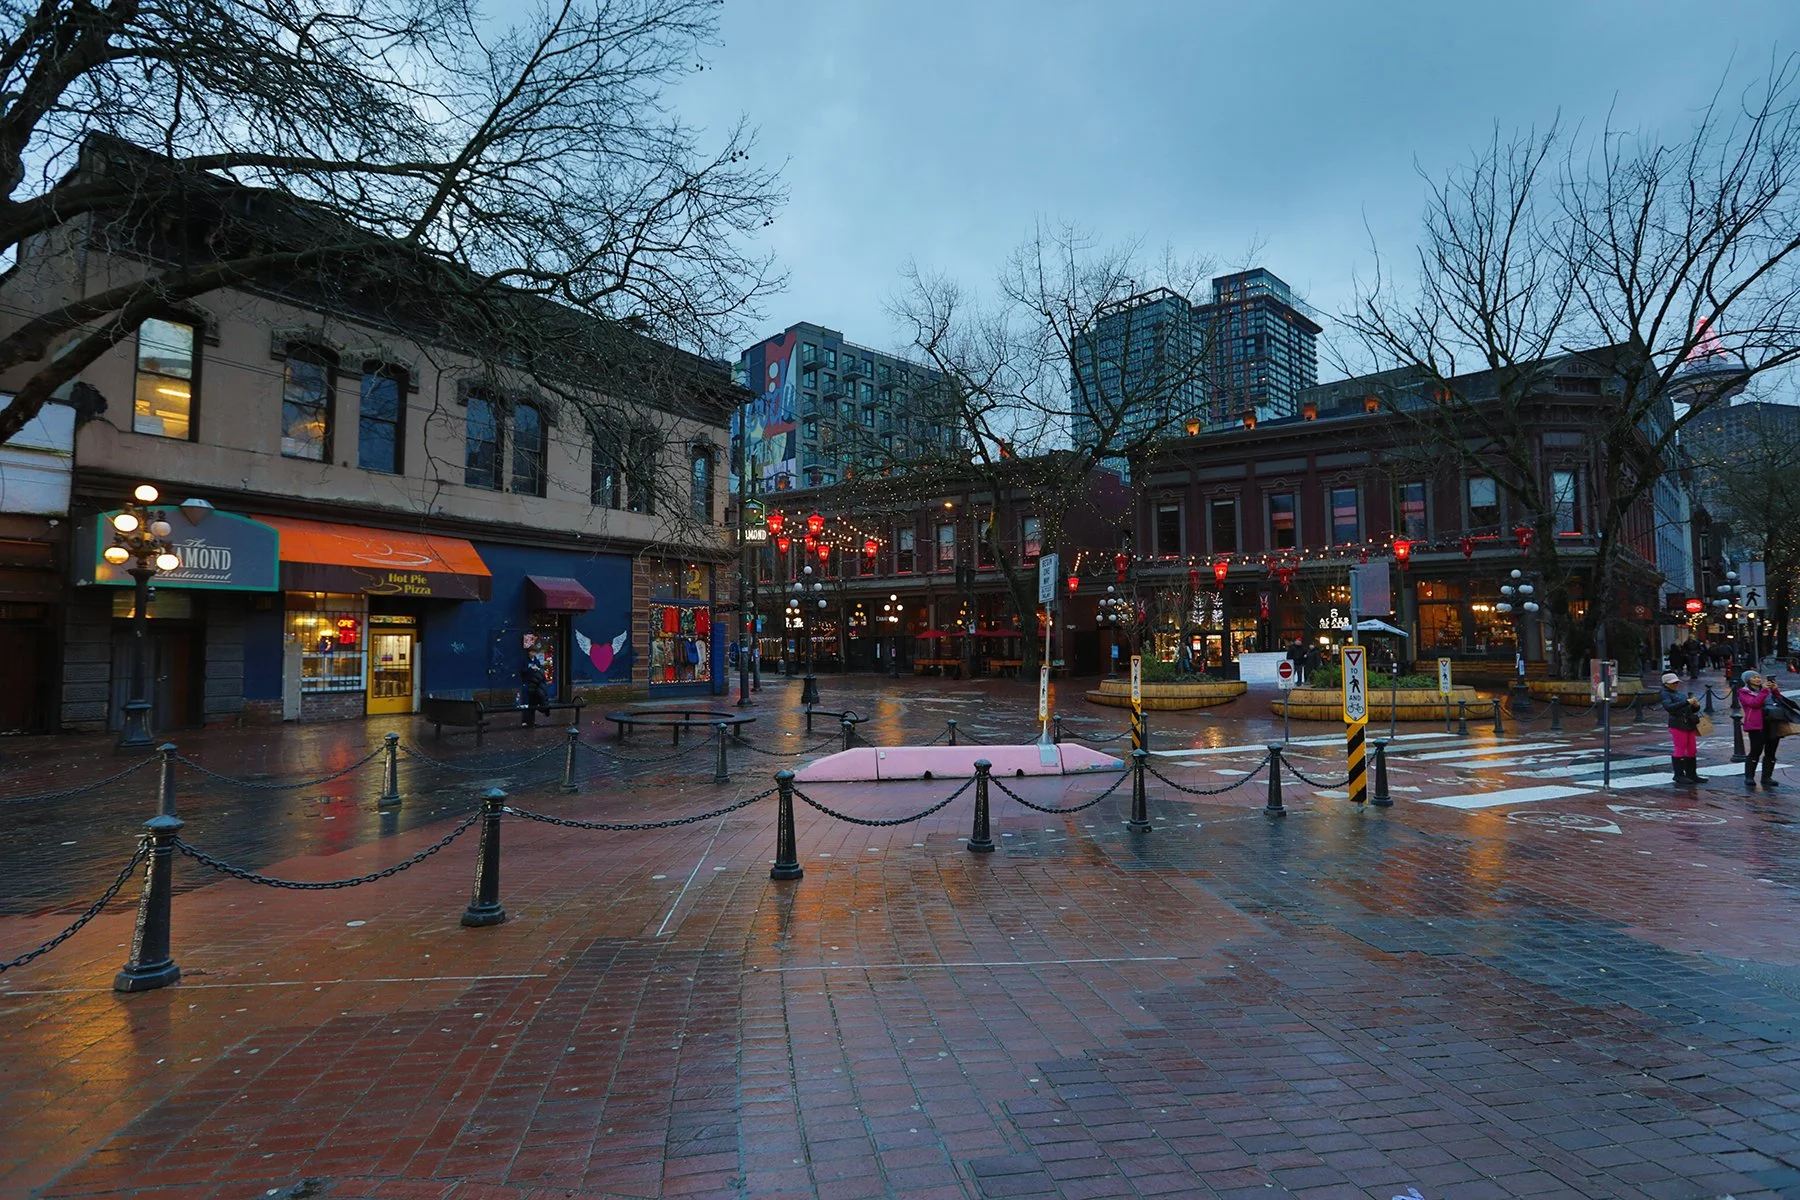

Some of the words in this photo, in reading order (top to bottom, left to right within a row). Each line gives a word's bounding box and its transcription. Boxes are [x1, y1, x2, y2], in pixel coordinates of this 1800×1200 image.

[737, 529, 767, 540] AMOND
[185, 538, 206, 548] The
[156, 547, 231, 570] AMOND
[388, 572, 408, 584] Hot
[410, 573, 428, 585] Pie
[403, 585, 432, 595] Pizza
